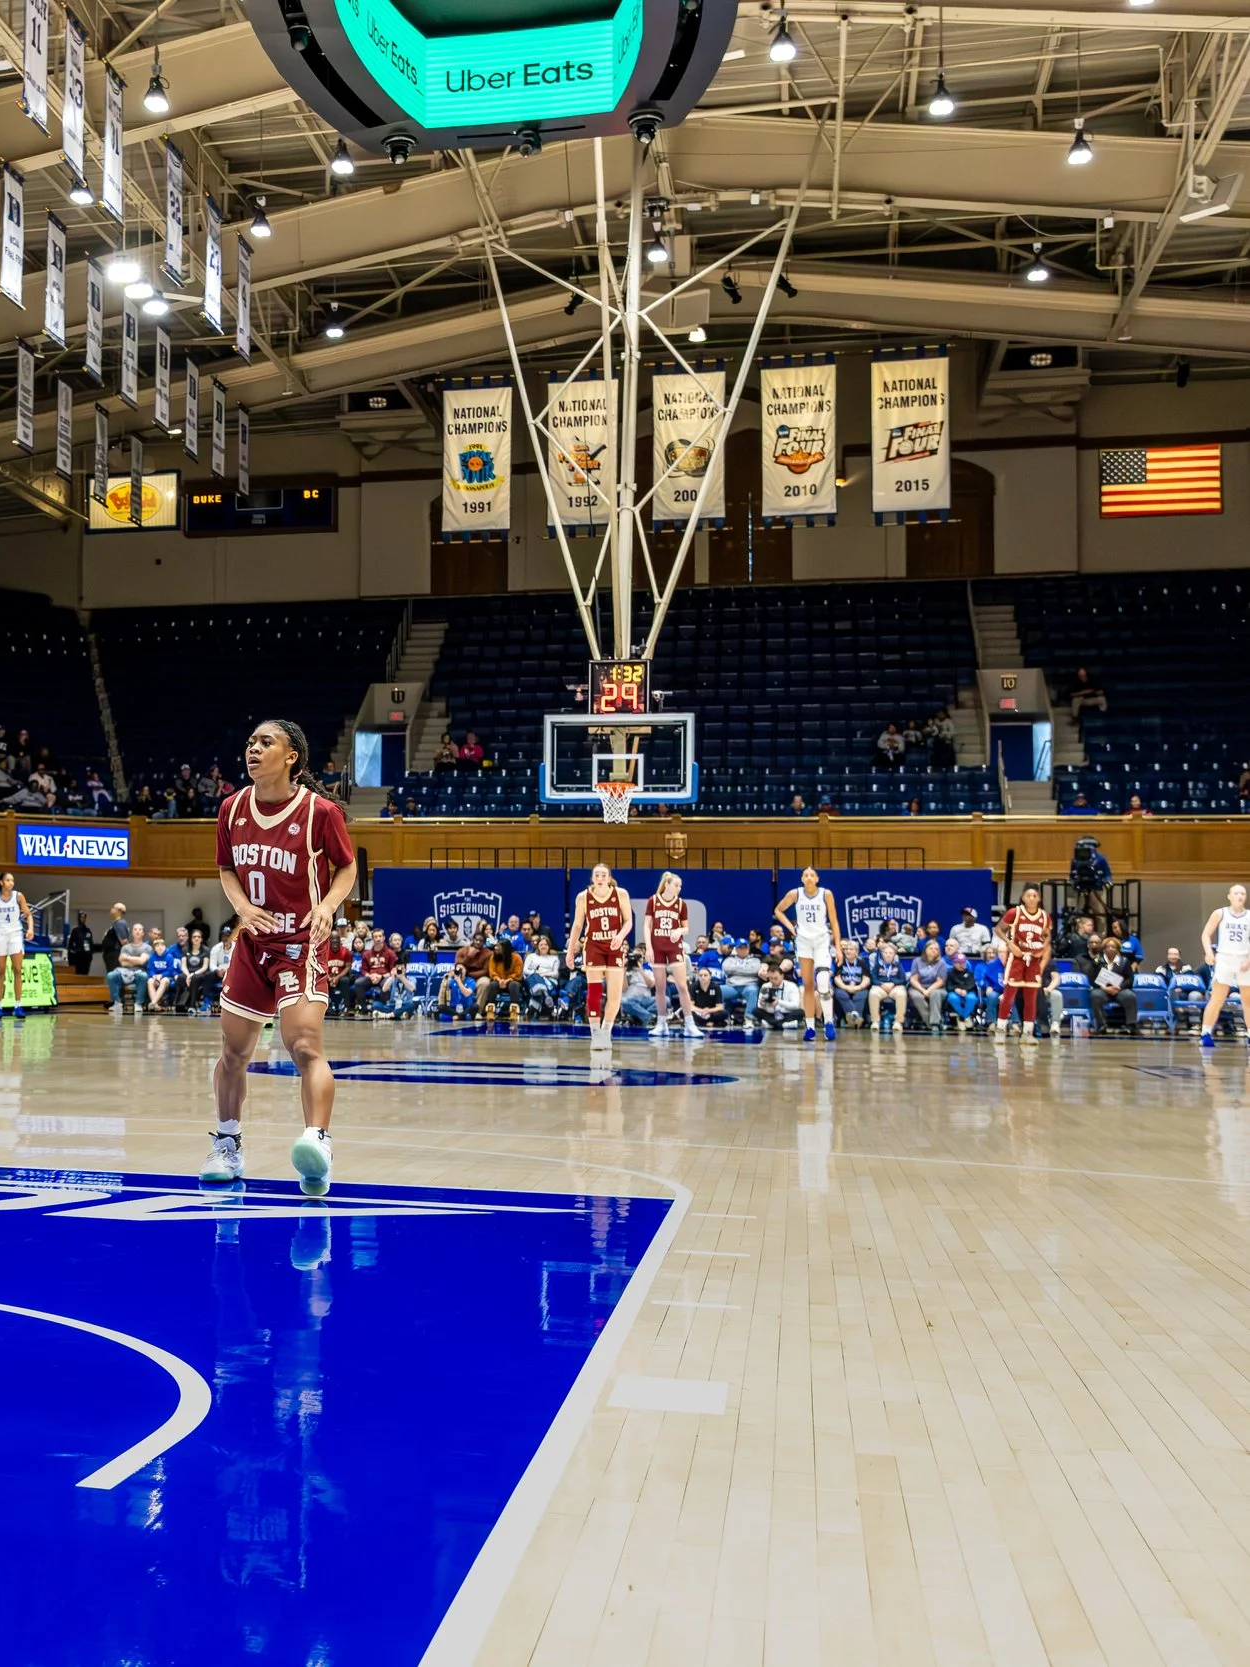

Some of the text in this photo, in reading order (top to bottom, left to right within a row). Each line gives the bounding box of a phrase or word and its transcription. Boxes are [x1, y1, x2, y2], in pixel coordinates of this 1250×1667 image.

[30, 17, 42, 55] 11
[366, 8, 418, 85] Uber Eats
[446, 61, 593, 93] Uber Eats
[772, 385, 826, 400] NATIONAL
[883, 377, 938, 393] NATIONAL
[663, 391, 715, 405] NATIONAL
[877, 392, 945, 410] CHAMPIONS
[453, 406, 502, 420] NATIONAL
[558, 399, 607, 413] NATIONAL
[766, 400, 832, 416] CHAMPIONS
[447, 420, 508, 437] CHAMPIONS
[552, 414, 608, 430] CHAMPION
[787, 427, 825, 442] FINAL
[907, 421, 943, 440] FINAL
[890, 434, 942, 460] FOUR
[783, 483, 819, 498] 2010
[895, 478, 930, 493] 2015
[192, 494, 222, 504] DUKE
[303, 489, 319, 501] BC
[568, 495, 598, 509] 1992
[673, 489, 698, 502] 200
[462, 501, 492, 514] 1991
[612, 665, 643, 683] 1:32
[600, 683, 638, 712] 29
[18, 833, 127, 857] WRAL NEWS
[231, 843, 298, 875] BOSTON
[248, 870, 266, 906] 0
[439, 902, 496, 918] SISTERHOOD
[589, 907, 619, 919] BOSTON
[654, 909, 680, 920] BOSTON
[805, 911, 817, 923] 21
[851, 906, 916, 923] SISTERHOOD
[5, 913, 11, 923] 4
[600, 917, 611, 931] 8
[1225, 922, 1248, 931] DUKE
[591, 929, 618, 941] COLLE
[1228, 931, 1244, 942] 25
[406, 963, 424, 973] DUKE
[1060, 973, 1083, 984] DUKE
[1136, 975, 1161, 985] DUKE
[1175, 974, 1199, 985] DUKE
